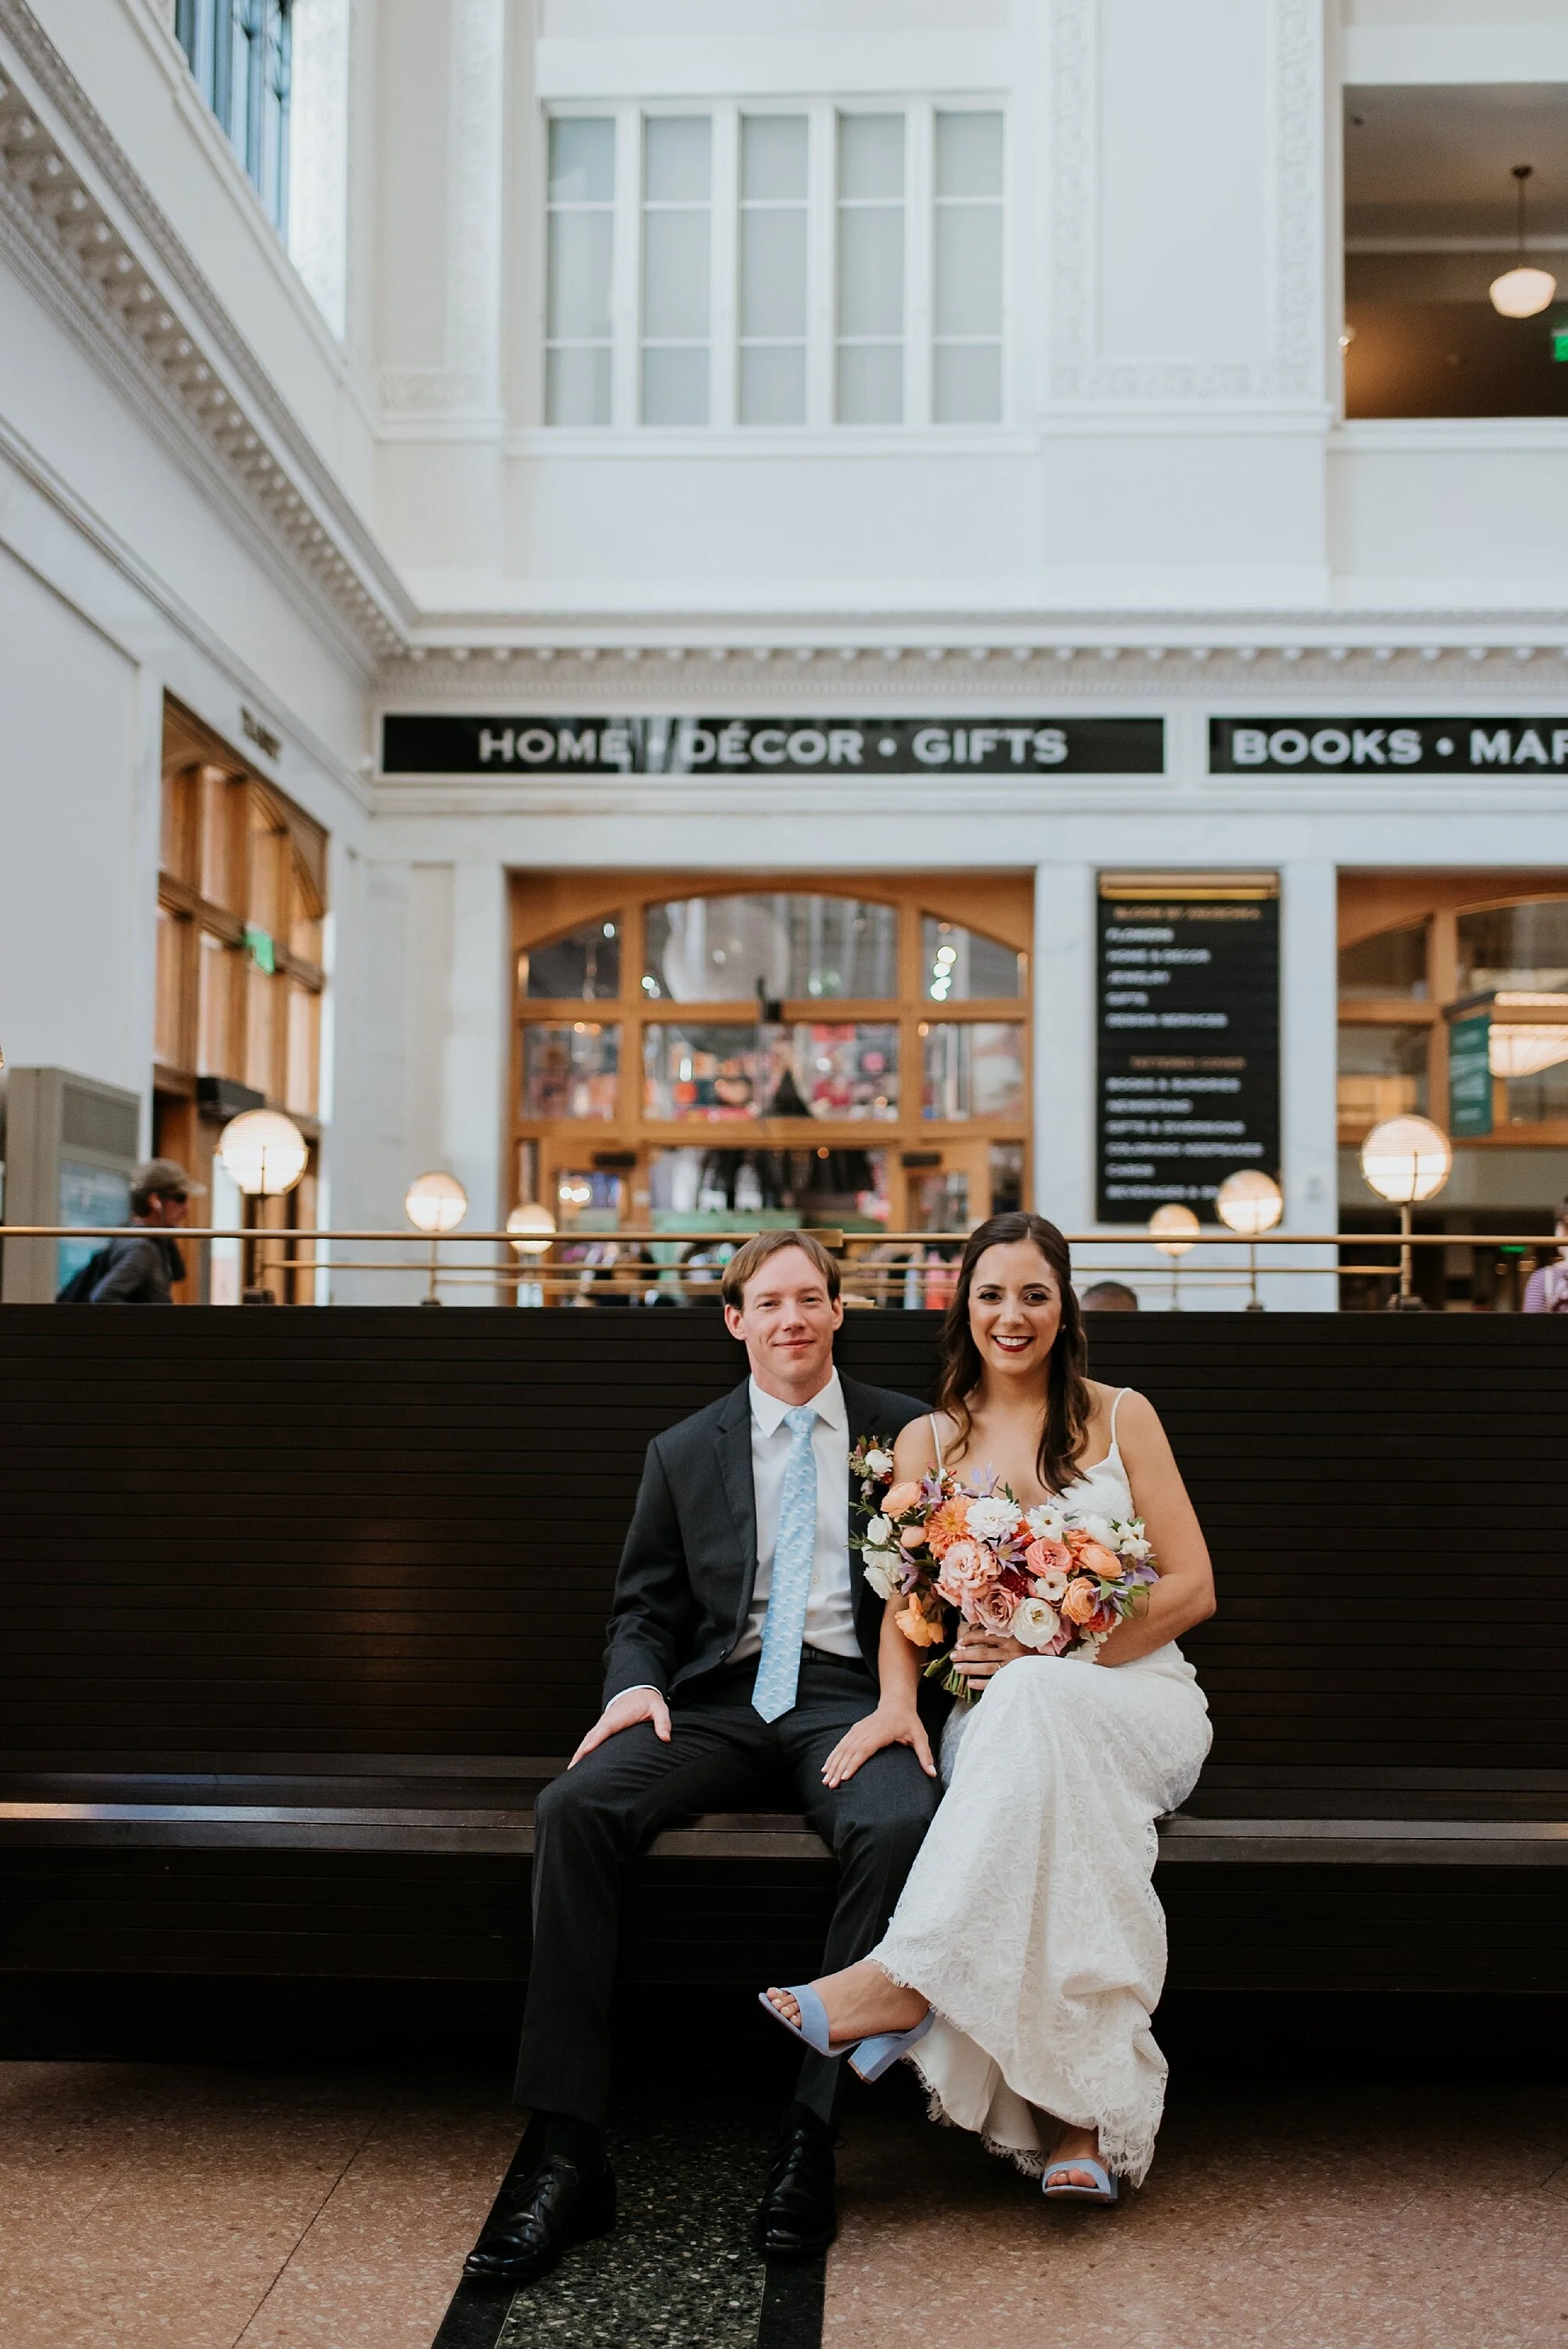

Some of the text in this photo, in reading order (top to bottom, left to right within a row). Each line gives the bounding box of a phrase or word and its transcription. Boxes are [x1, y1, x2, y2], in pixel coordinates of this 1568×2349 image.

[478, 720, 1069, 765] HOME DÉCOR GIFTS
[1231, 728, 1422, 765] BOOKS
